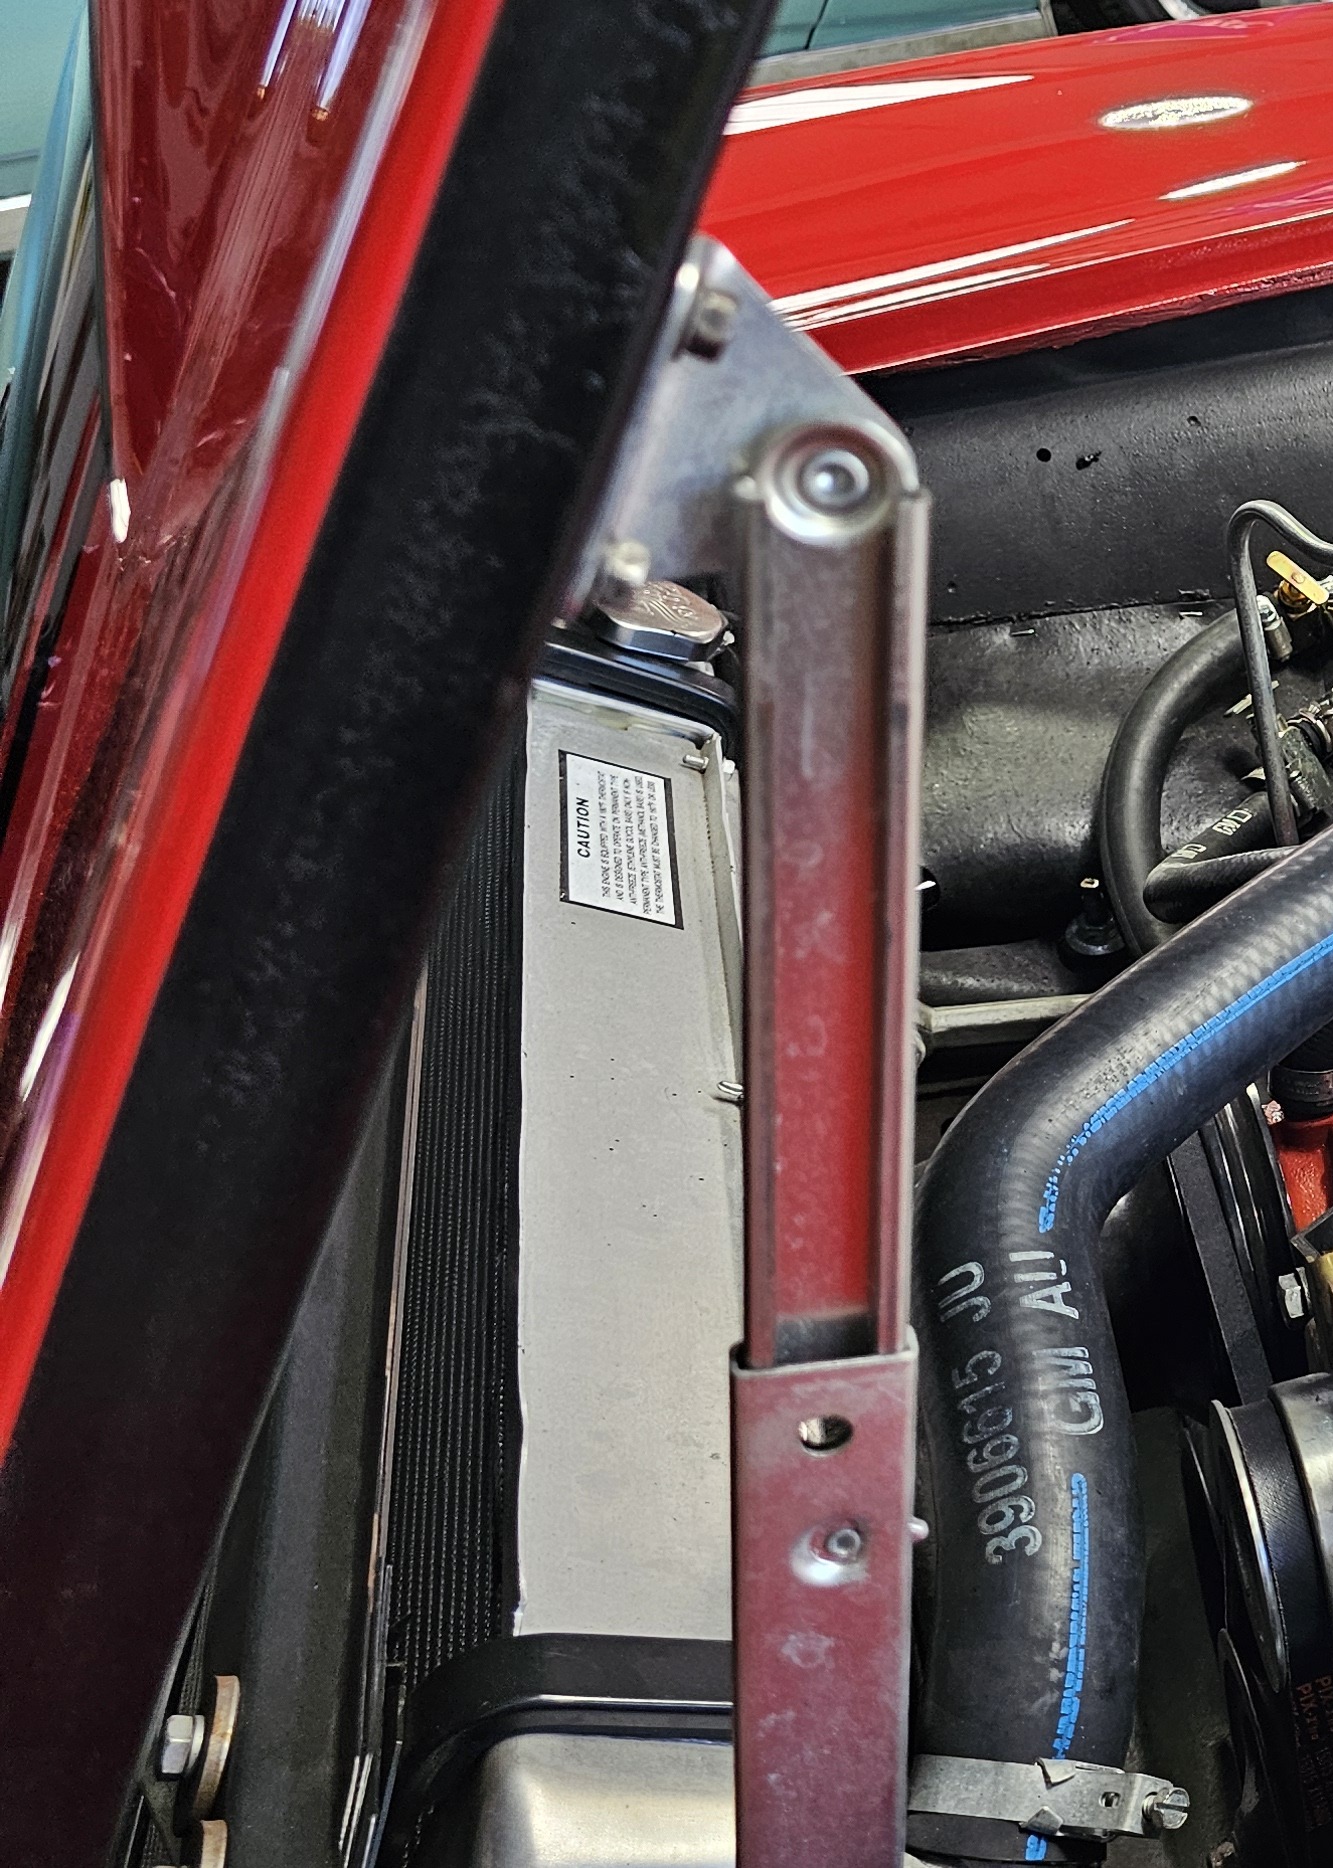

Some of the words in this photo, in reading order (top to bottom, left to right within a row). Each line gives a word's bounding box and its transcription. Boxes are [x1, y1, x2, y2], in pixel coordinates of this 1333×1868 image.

[576, 797, 591, 859] CAUTION
[1031, 1346, 1104, 1436] GM
[951, 1350, 1042, 1565] 3906615
